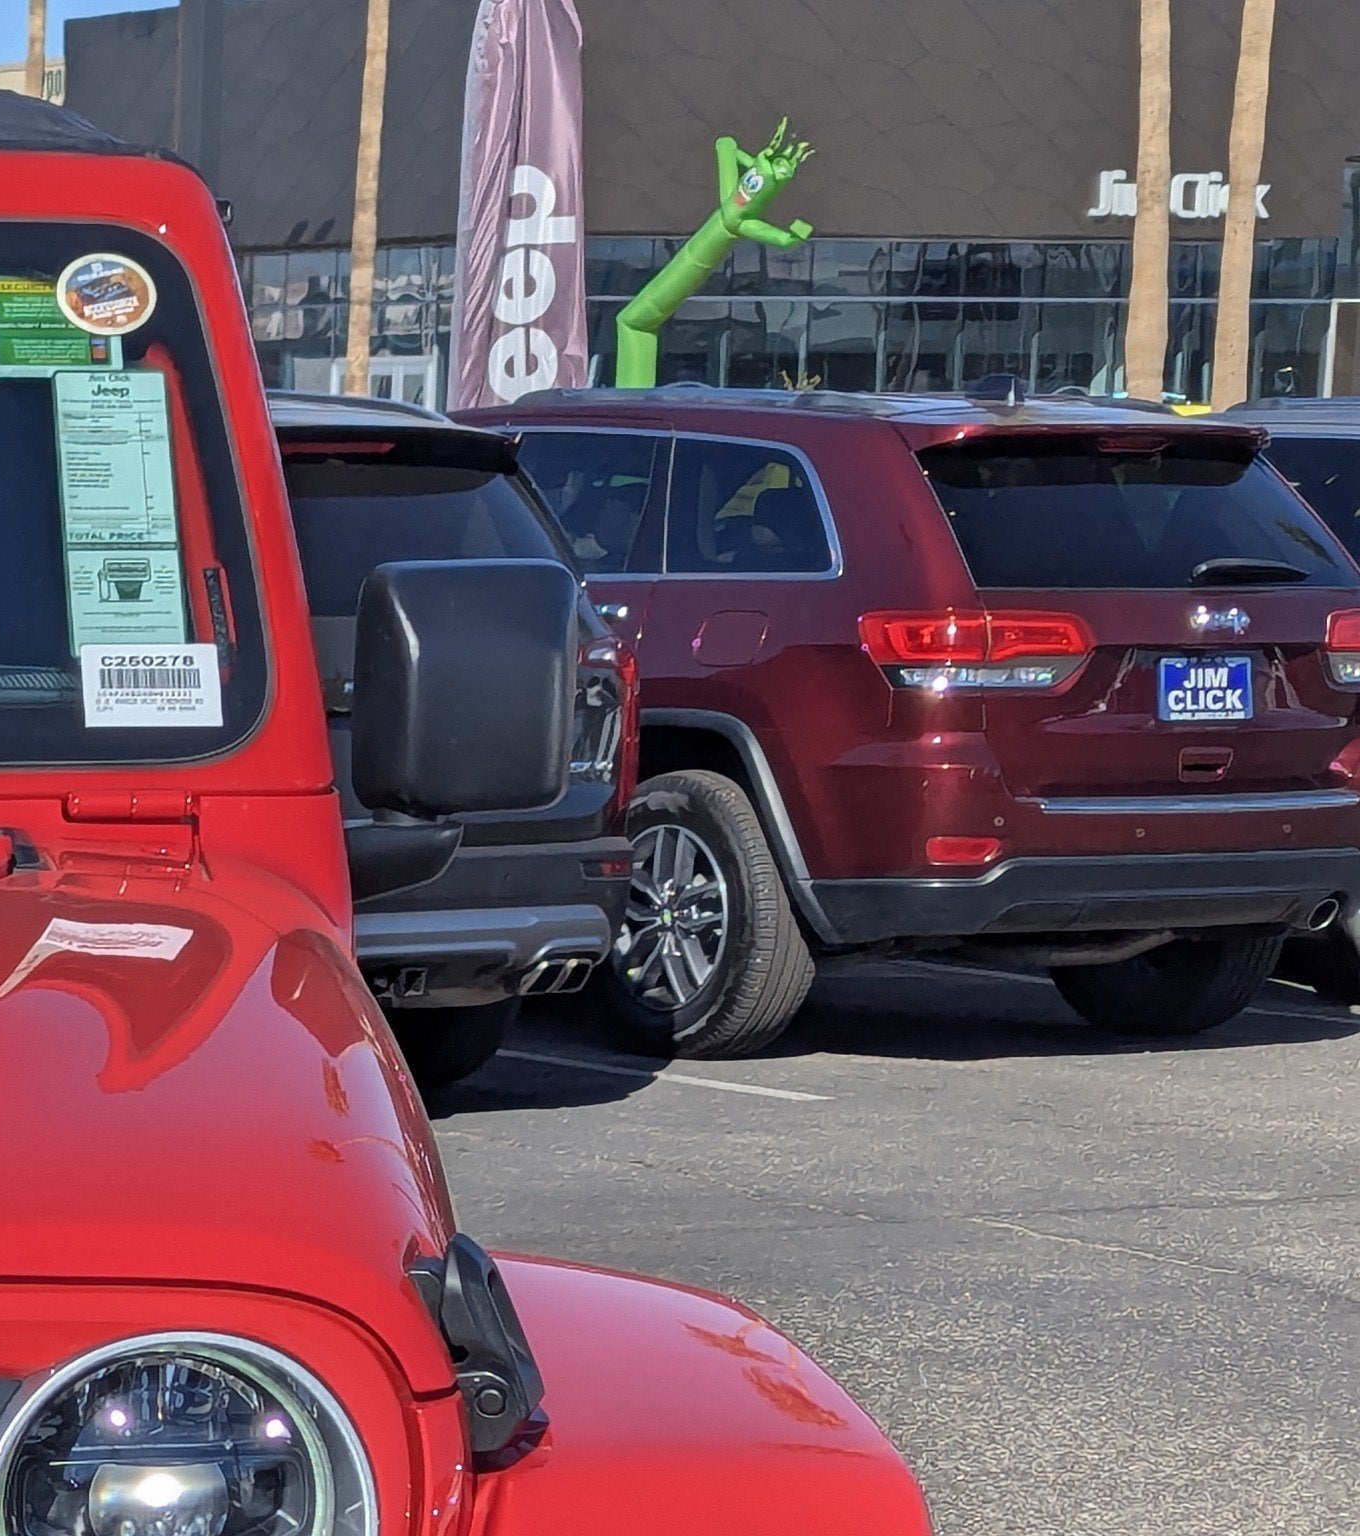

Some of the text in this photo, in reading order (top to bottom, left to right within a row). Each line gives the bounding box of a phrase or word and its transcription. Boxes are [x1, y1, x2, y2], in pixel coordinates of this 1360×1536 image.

[1087, 169, 1138, 217] Ji
[488, 165, 578, 405] eep
[91, 384, 130, 398] Jeep
[69, 531, 145, 541] TOTAL PRICE
[1182, 667, 1229, 689] JIM
[1167, 688, 1244, 711] CLICK
